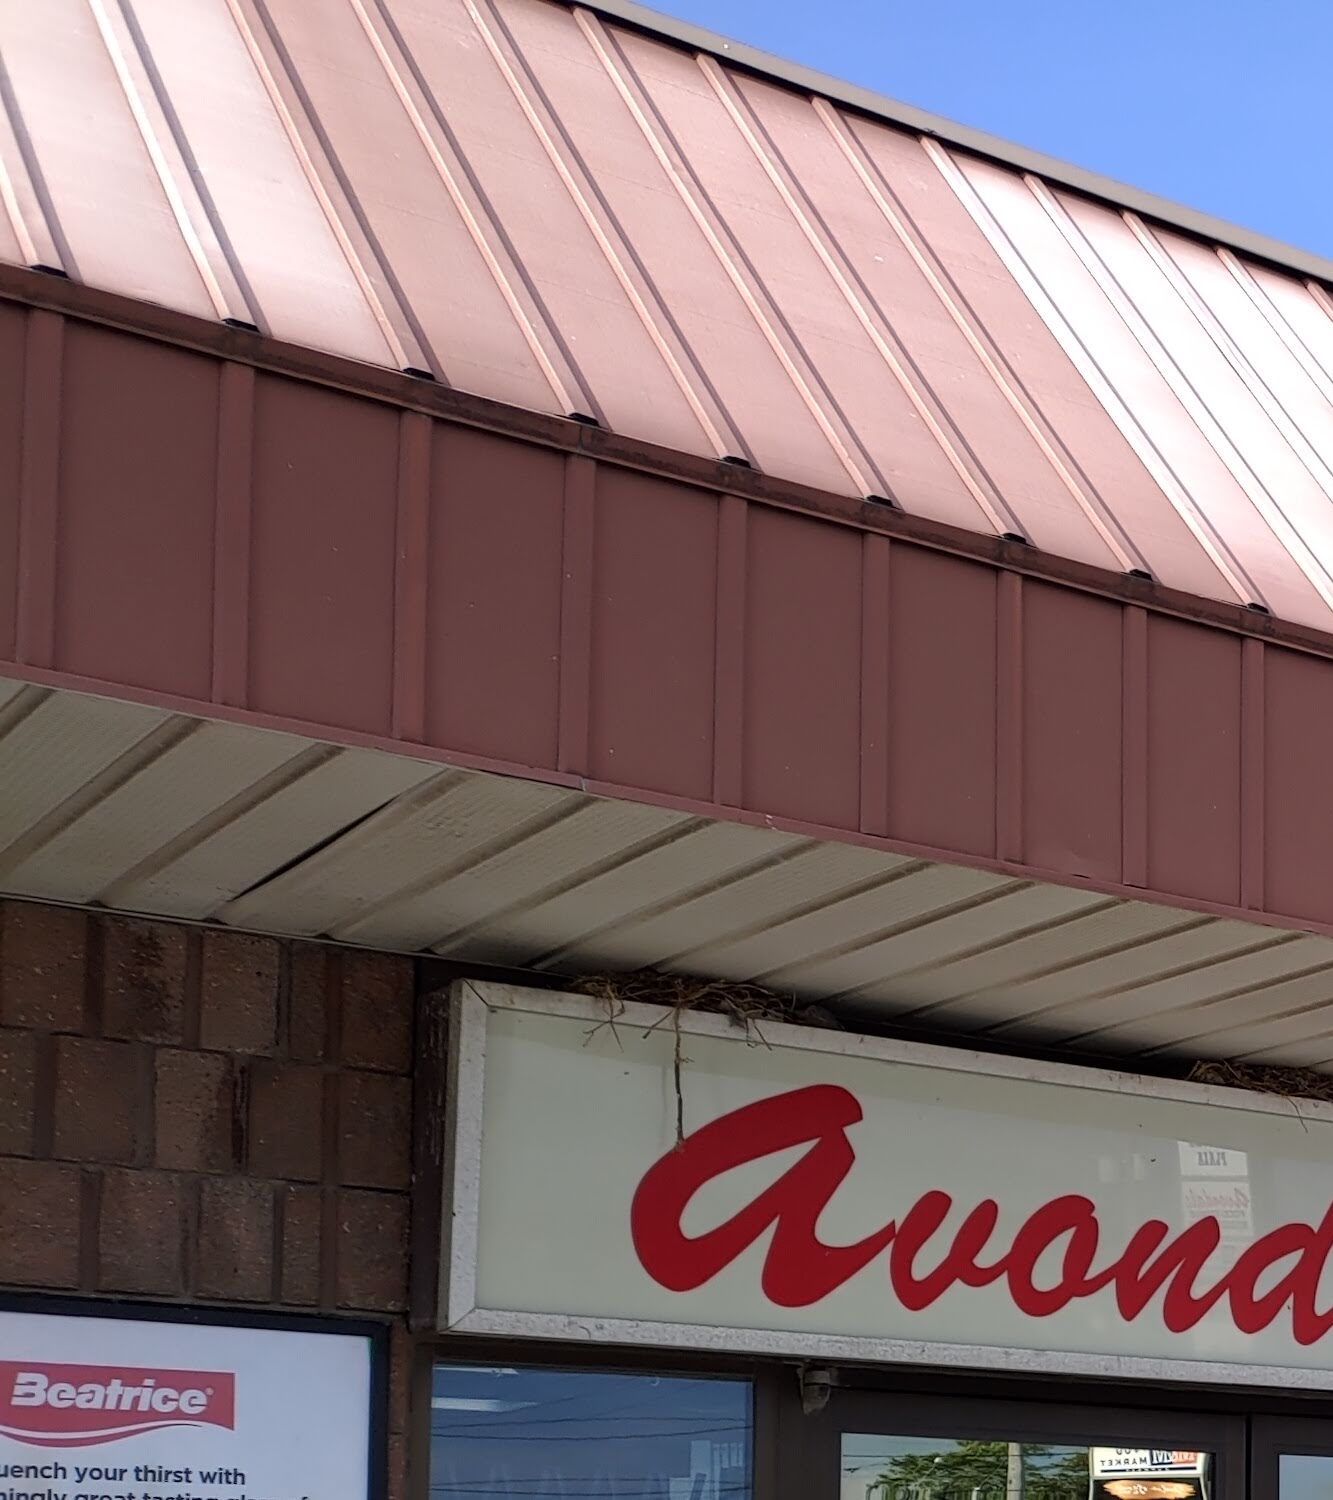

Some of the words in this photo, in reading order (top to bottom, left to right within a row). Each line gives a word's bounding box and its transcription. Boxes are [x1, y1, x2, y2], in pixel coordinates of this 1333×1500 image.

[11, 1372, 208, 1415] Beatrice
[75, 1467, 127, 1483] your
[134, 1465, 192, 1484] thirst
[199, 1468, 245, 1485] with
